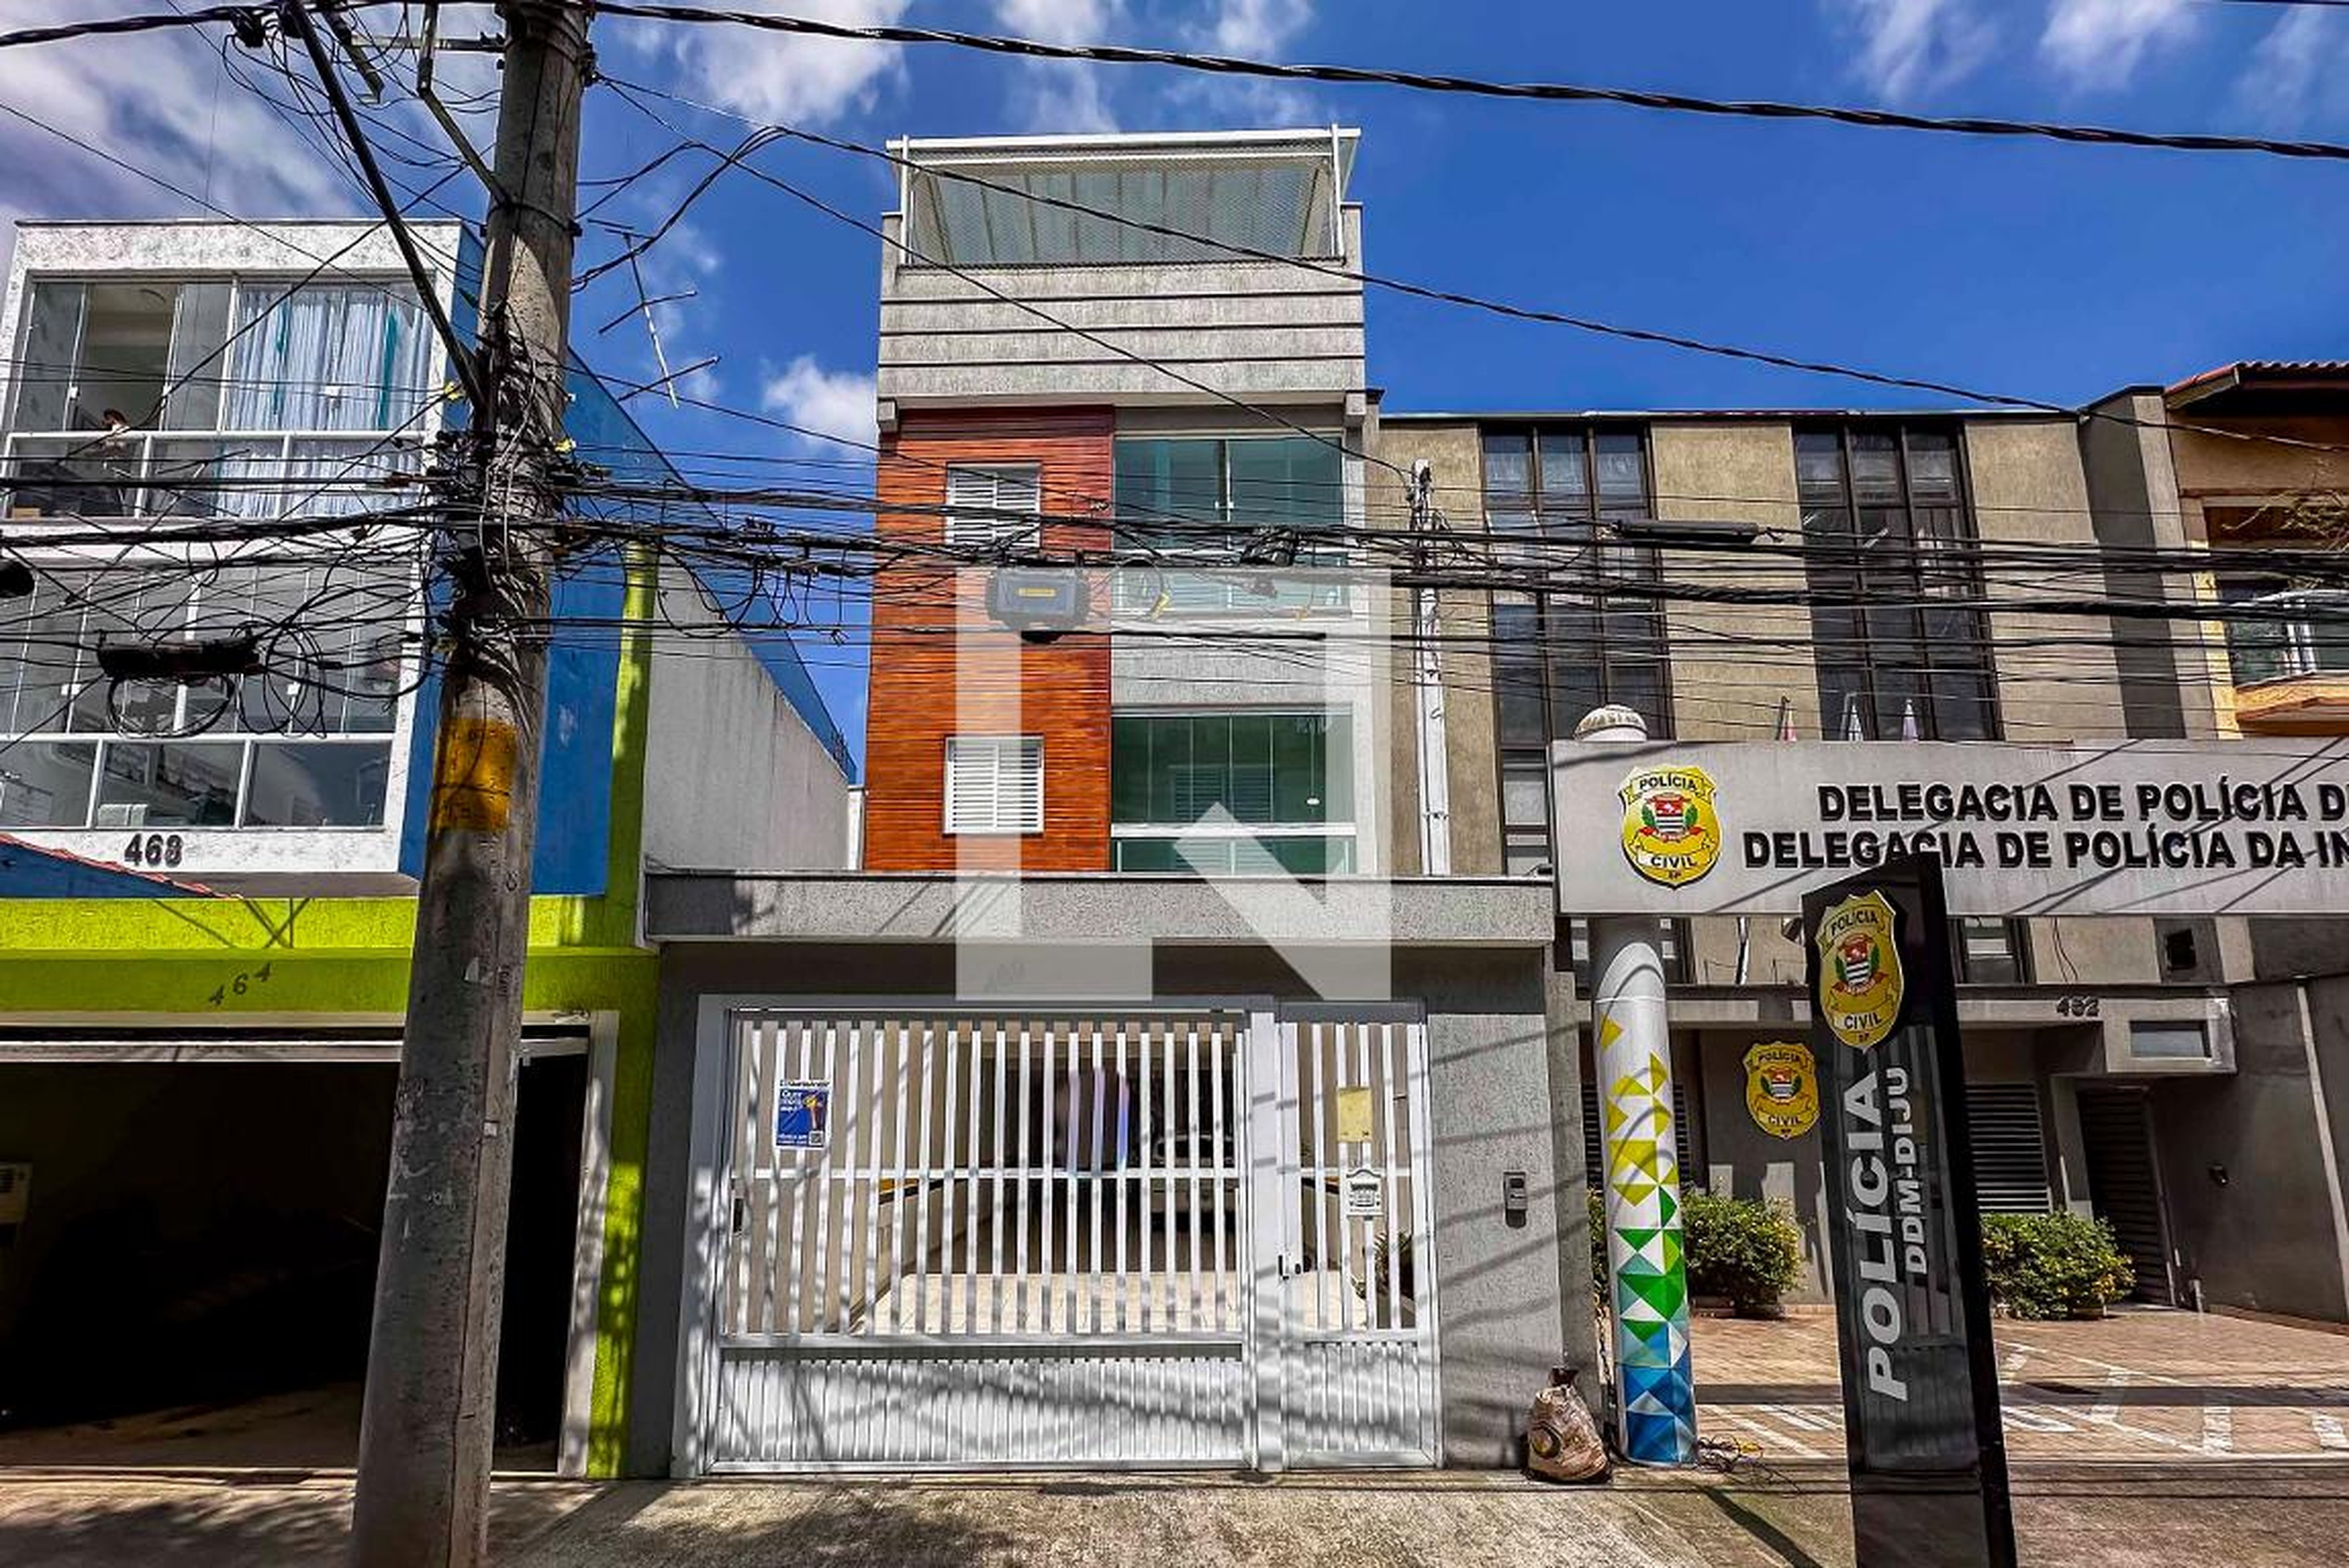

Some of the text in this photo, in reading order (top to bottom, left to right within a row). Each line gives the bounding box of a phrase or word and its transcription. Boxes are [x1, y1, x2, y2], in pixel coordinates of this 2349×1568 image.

[1639, 773, 1697, 791] POLÍCIA
[1817, 783, 2058, 821] DELEGACIA
[2068, 784, 2124, 821] DE
[2136, 775, 2308, 821] POLÍCIA
[124, 833, 183, 868] 468
[1650, 856, 1697, 868] CIVIL
[1995, 831, 2051, 868] DE
[2064, 823, 2236, 868] POLÍCIA
[2245, 831, 2306, 868] DA
[1831, 911, 1879, 936] POLÍCIA
[209, 962, 270, 1005] 464
[1844, 1012, 1882, 1029] CIVIL
[1886, 1067, 1927, 1274] DDM-DIJU
[1844, 1071, 1908, 1402] POLÍCIA
